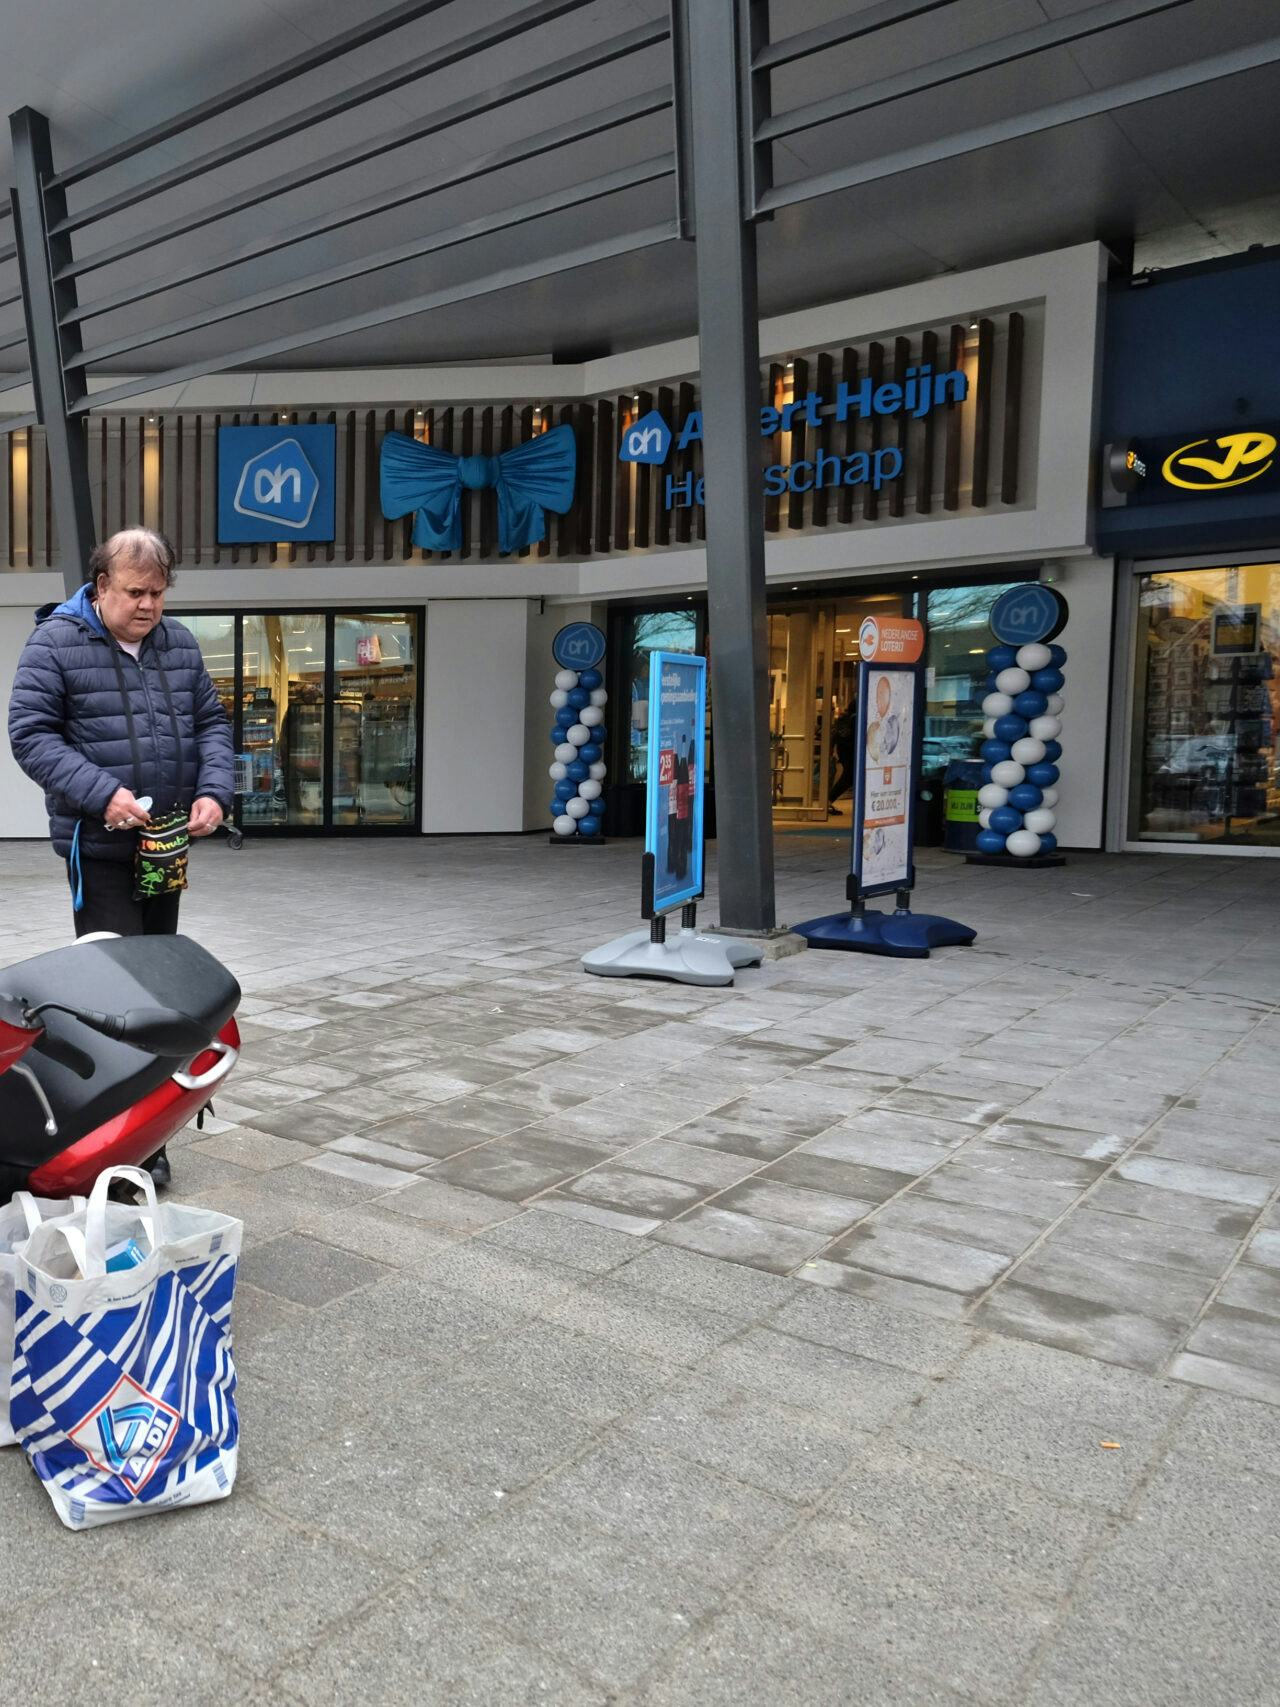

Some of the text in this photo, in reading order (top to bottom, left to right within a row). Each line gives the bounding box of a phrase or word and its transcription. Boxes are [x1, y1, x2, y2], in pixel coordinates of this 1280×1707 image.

[677, 364, 969, 450] Aert Heijn
[128, 1417, 169, 1478] ALDI
